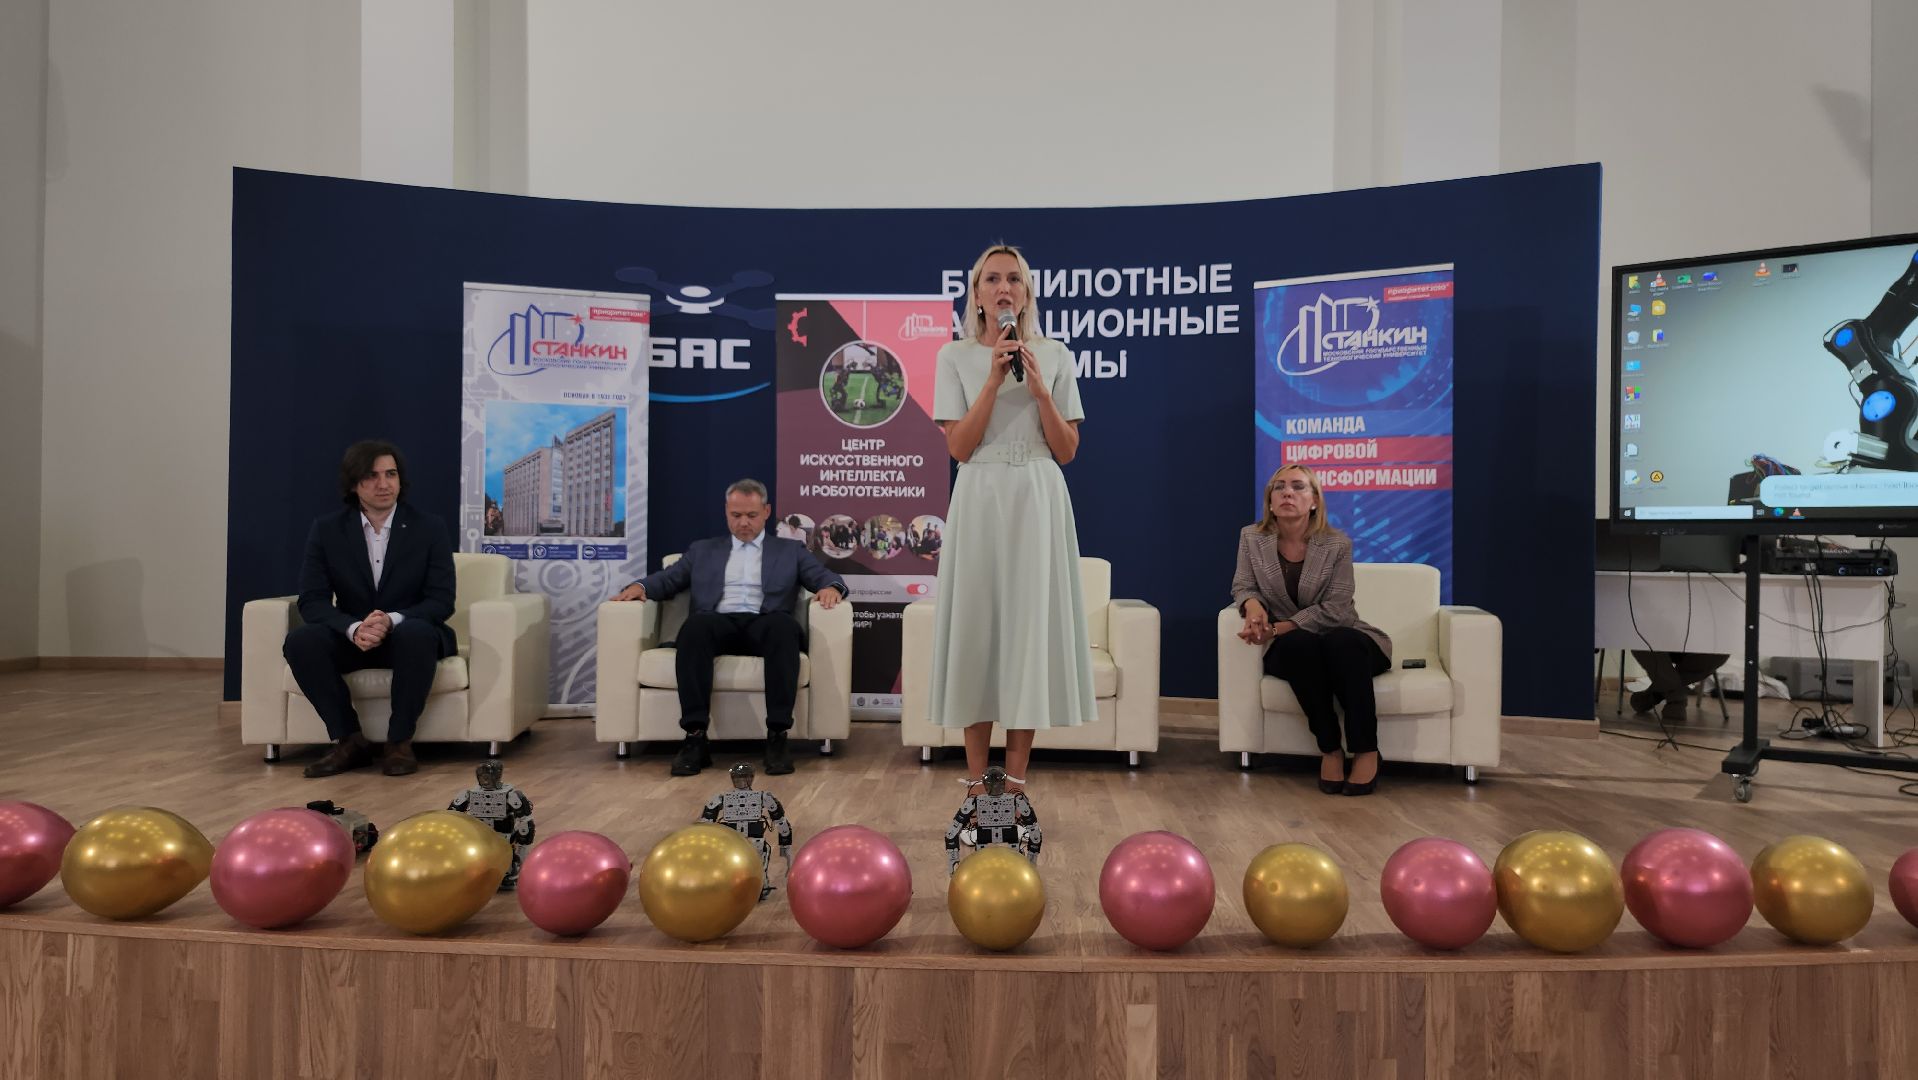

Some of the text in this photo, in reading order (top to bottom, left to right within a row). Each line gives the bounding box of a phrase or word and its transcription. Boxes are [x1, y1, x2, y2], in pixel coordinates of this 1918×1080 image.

[941, 263, 1233, 299] БПИЛОТНЫЕ
[952, 304, 1240, 344] АЦИОННЫЕ
[1321, 326, 1428, 351] СТАНКИН
[532, 341, 628, 360] СТАНКИН
[649, 337, 751, 370] БАС
[1286, 416, 1366, 435] КОМАНДА
[841, 439, 886, 452] ЦЕНТР
[1286, 439, 1378, 462] ЦИФРОВОЙ
[799, 454, 924, 467] ИСКУССТВЕННОГО
[819, 469, 906, 482] ИНТЕЛЛЕКТА
[1317, 468, 1437, 487] НСФОРМАЦИИ
[800, 485, 926, 498] И РОБОТОТЕХНИКИ
